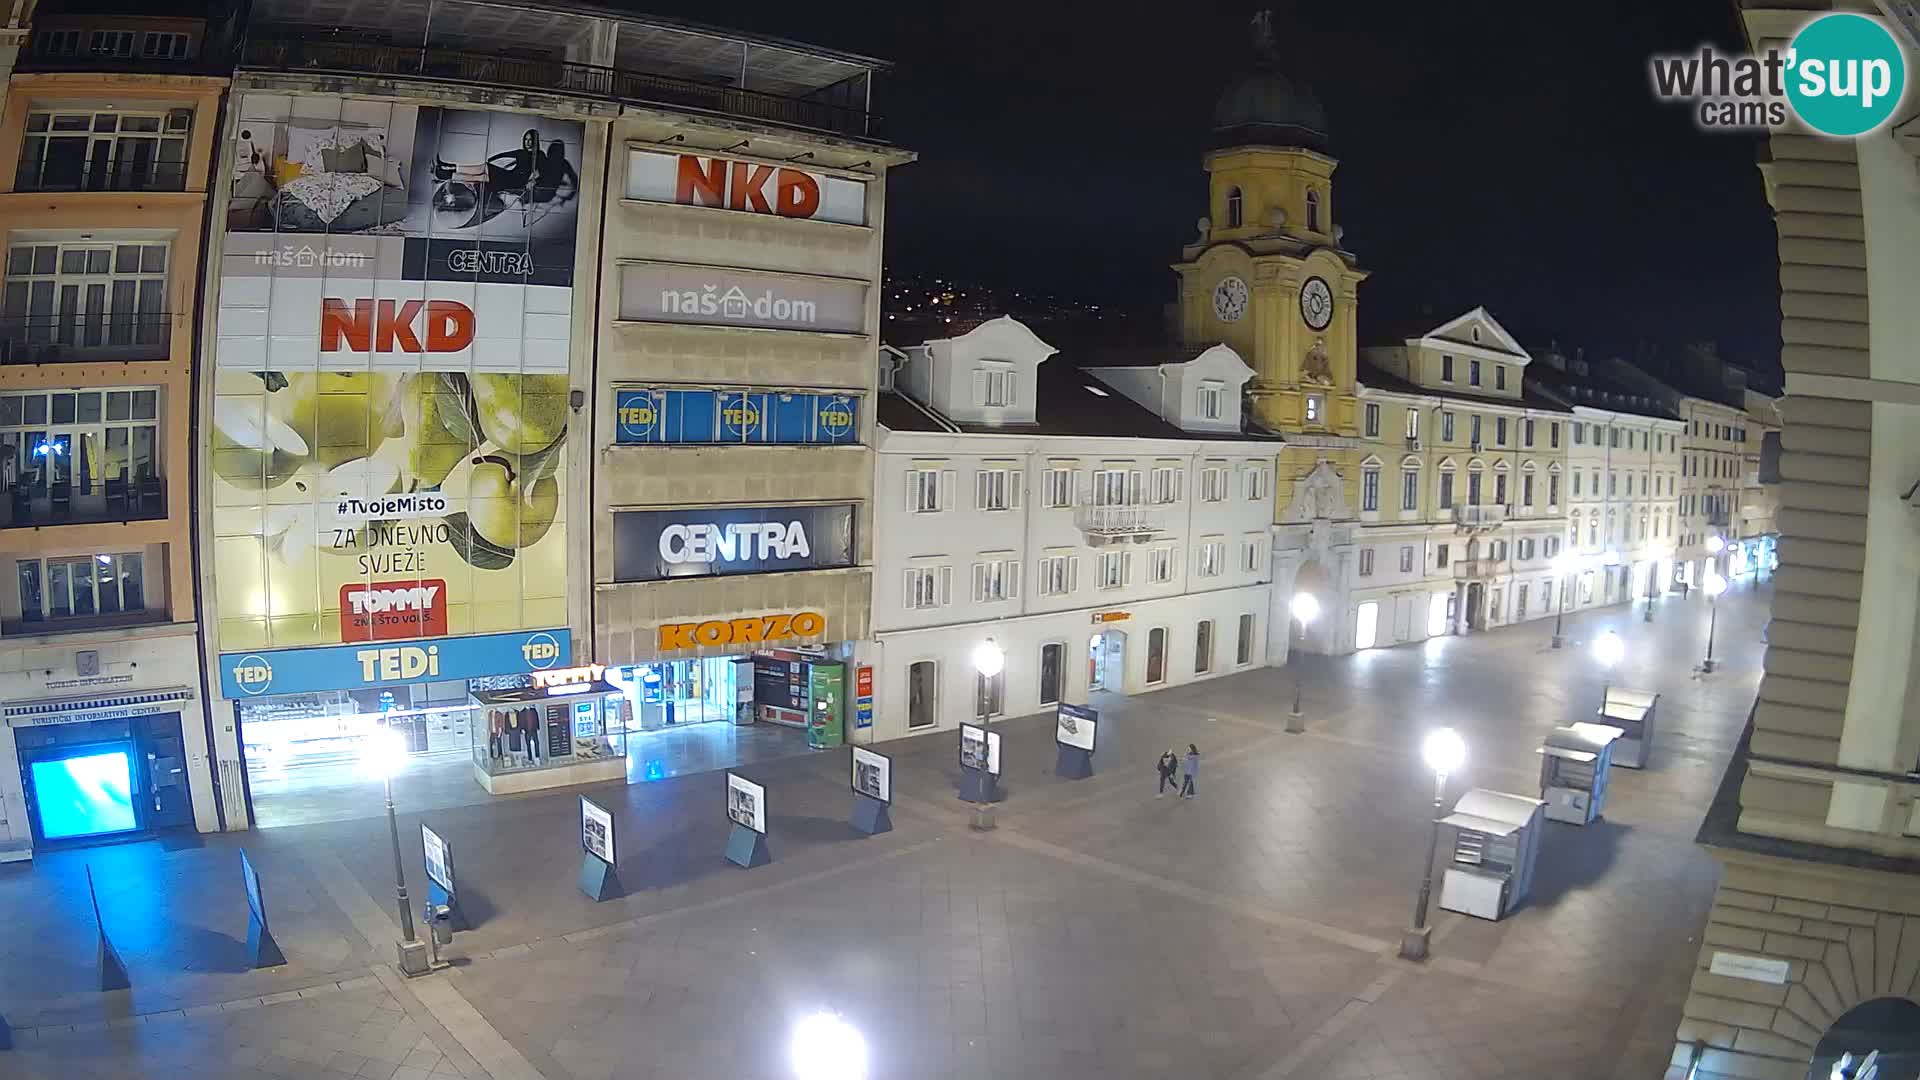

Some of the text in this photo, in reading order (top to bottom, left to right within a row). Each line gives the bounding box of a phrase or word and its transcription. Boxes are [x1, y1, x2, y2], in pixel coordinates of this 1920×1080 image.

[676, 154, 821, 219] NKD
[255, 245, 364, 268] naš dom
[448, 249, 535, 275] CENTRA
[661, 283, 816, 322] naš dom
[320, 297, 476, 352] NKD
[618, 408, 657, 424] TEDi
[723, 409, 760, 425] TEDi
[820, 411, 853, 426] TEDi
[337, 497, 446, 515] #TvojeMisto
[333, 523, 450, 549] ZA DNEVNO
[659, 520, 810, 564] CENTRA
[359, 548, 425, 575] SVJEŽE
[348, 586, 439, 614] TOMMY
[379, 613, 399, 625] ŠTO
[659, 612, 826, 651] KORZO
[357, 645, 439, 682] TEDi
[522, 642, 559, 660] TEDi
[233, 666, 273, 684] TEDi
